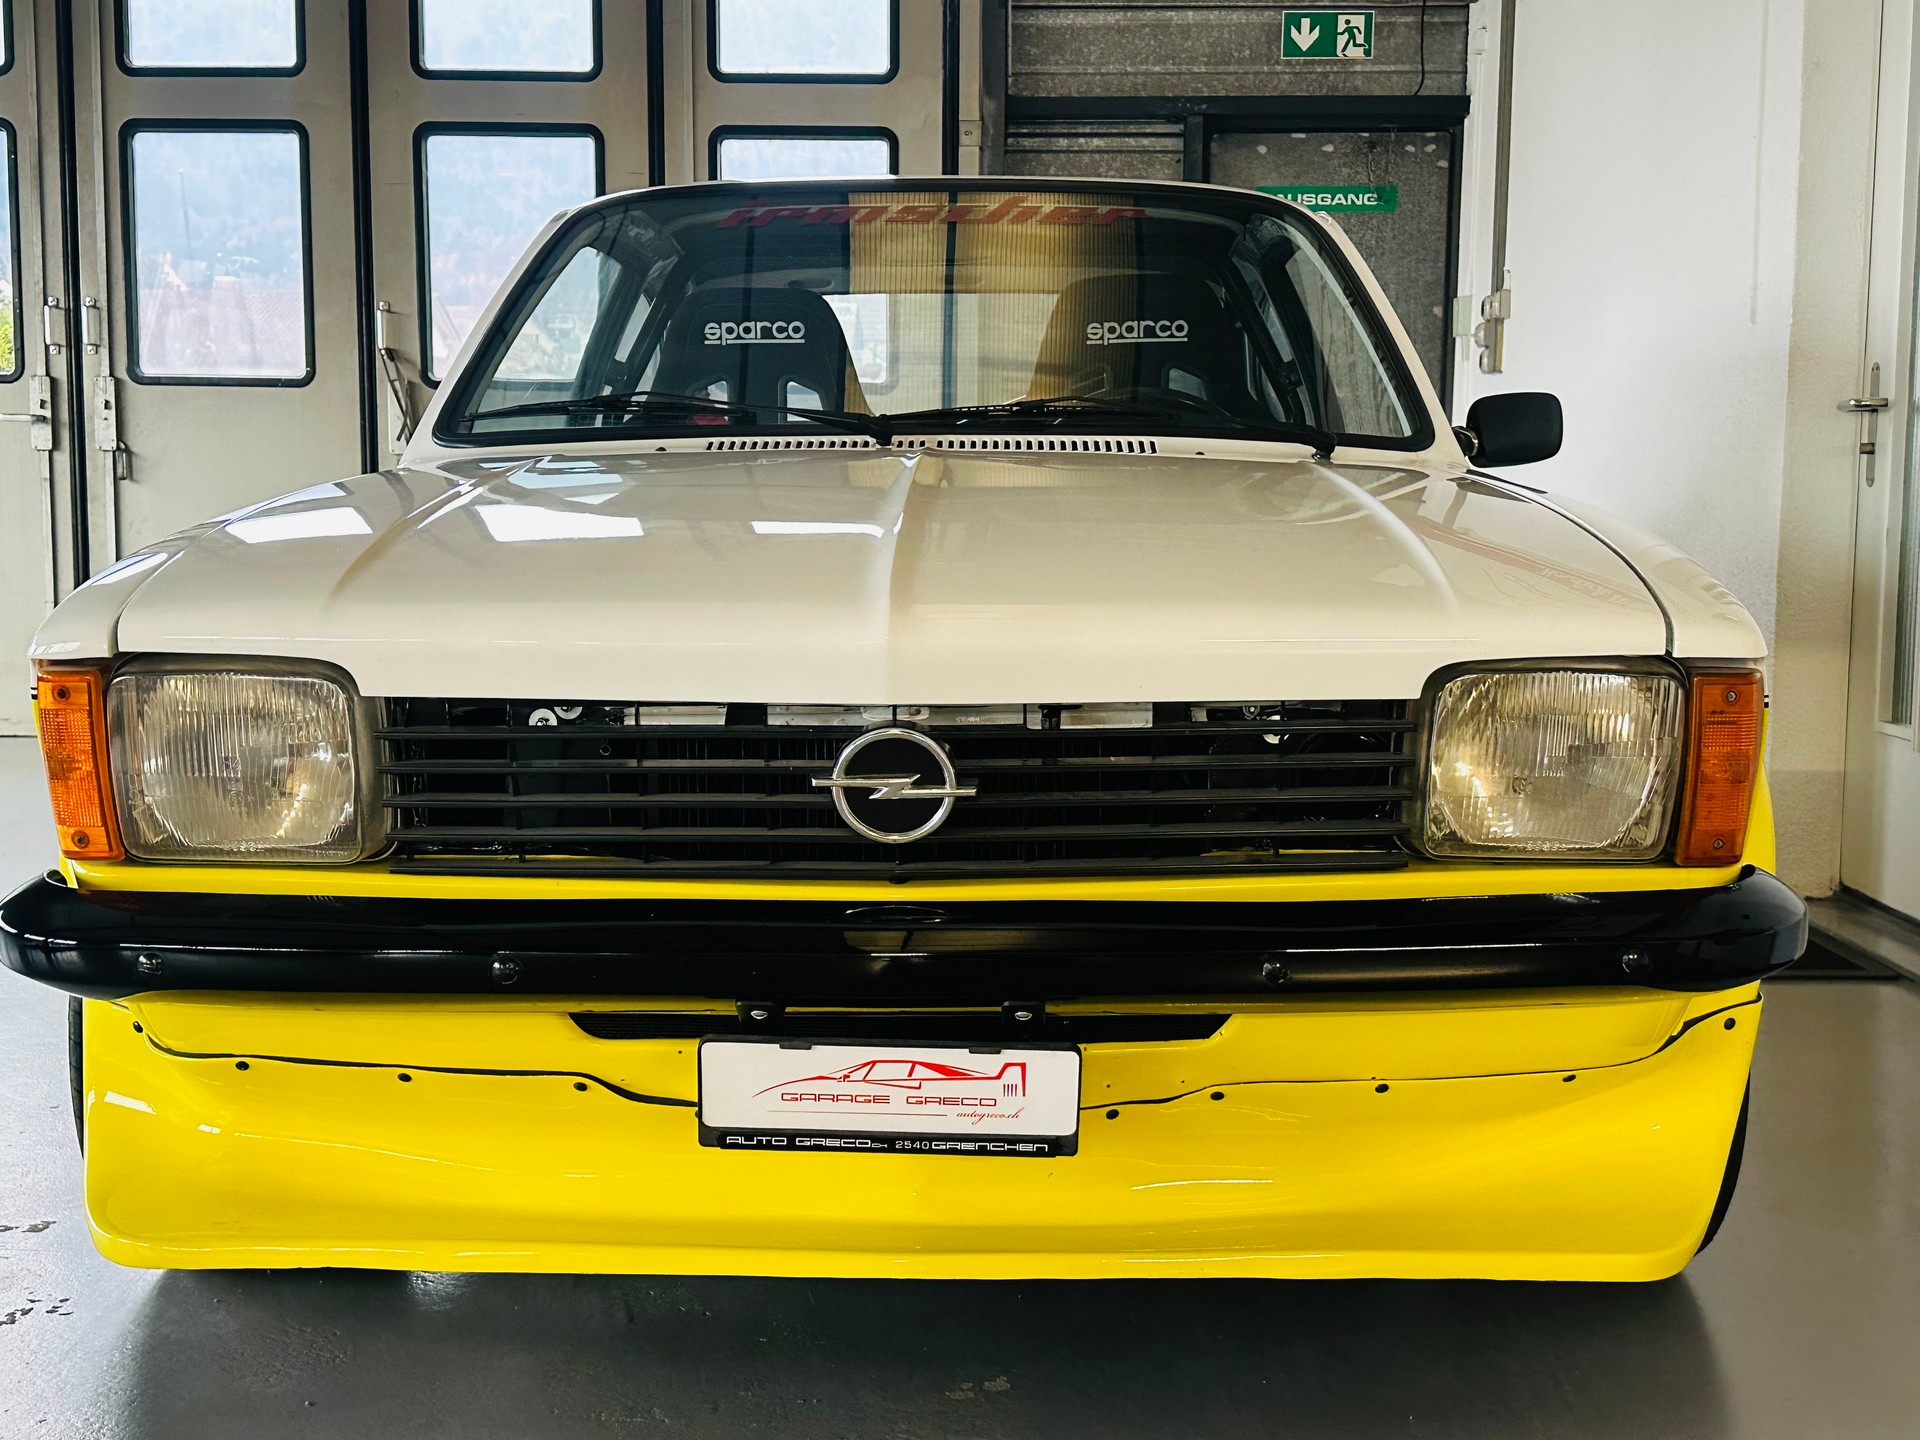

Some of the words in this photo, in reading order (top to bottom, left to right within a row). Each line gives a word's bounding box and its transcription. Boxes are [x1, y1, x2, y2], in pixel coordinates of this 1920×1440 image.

[704, 321, 806, 346] sparco
[1086, 319, 1189, 346] sparco
[781, 1092, 890, 1104] GARAGE
[906, 1096, 997, 1107] GRECO
[726, 1136, 787, 1146] AUTO
[895, 1140, 930, 1150] 2540
